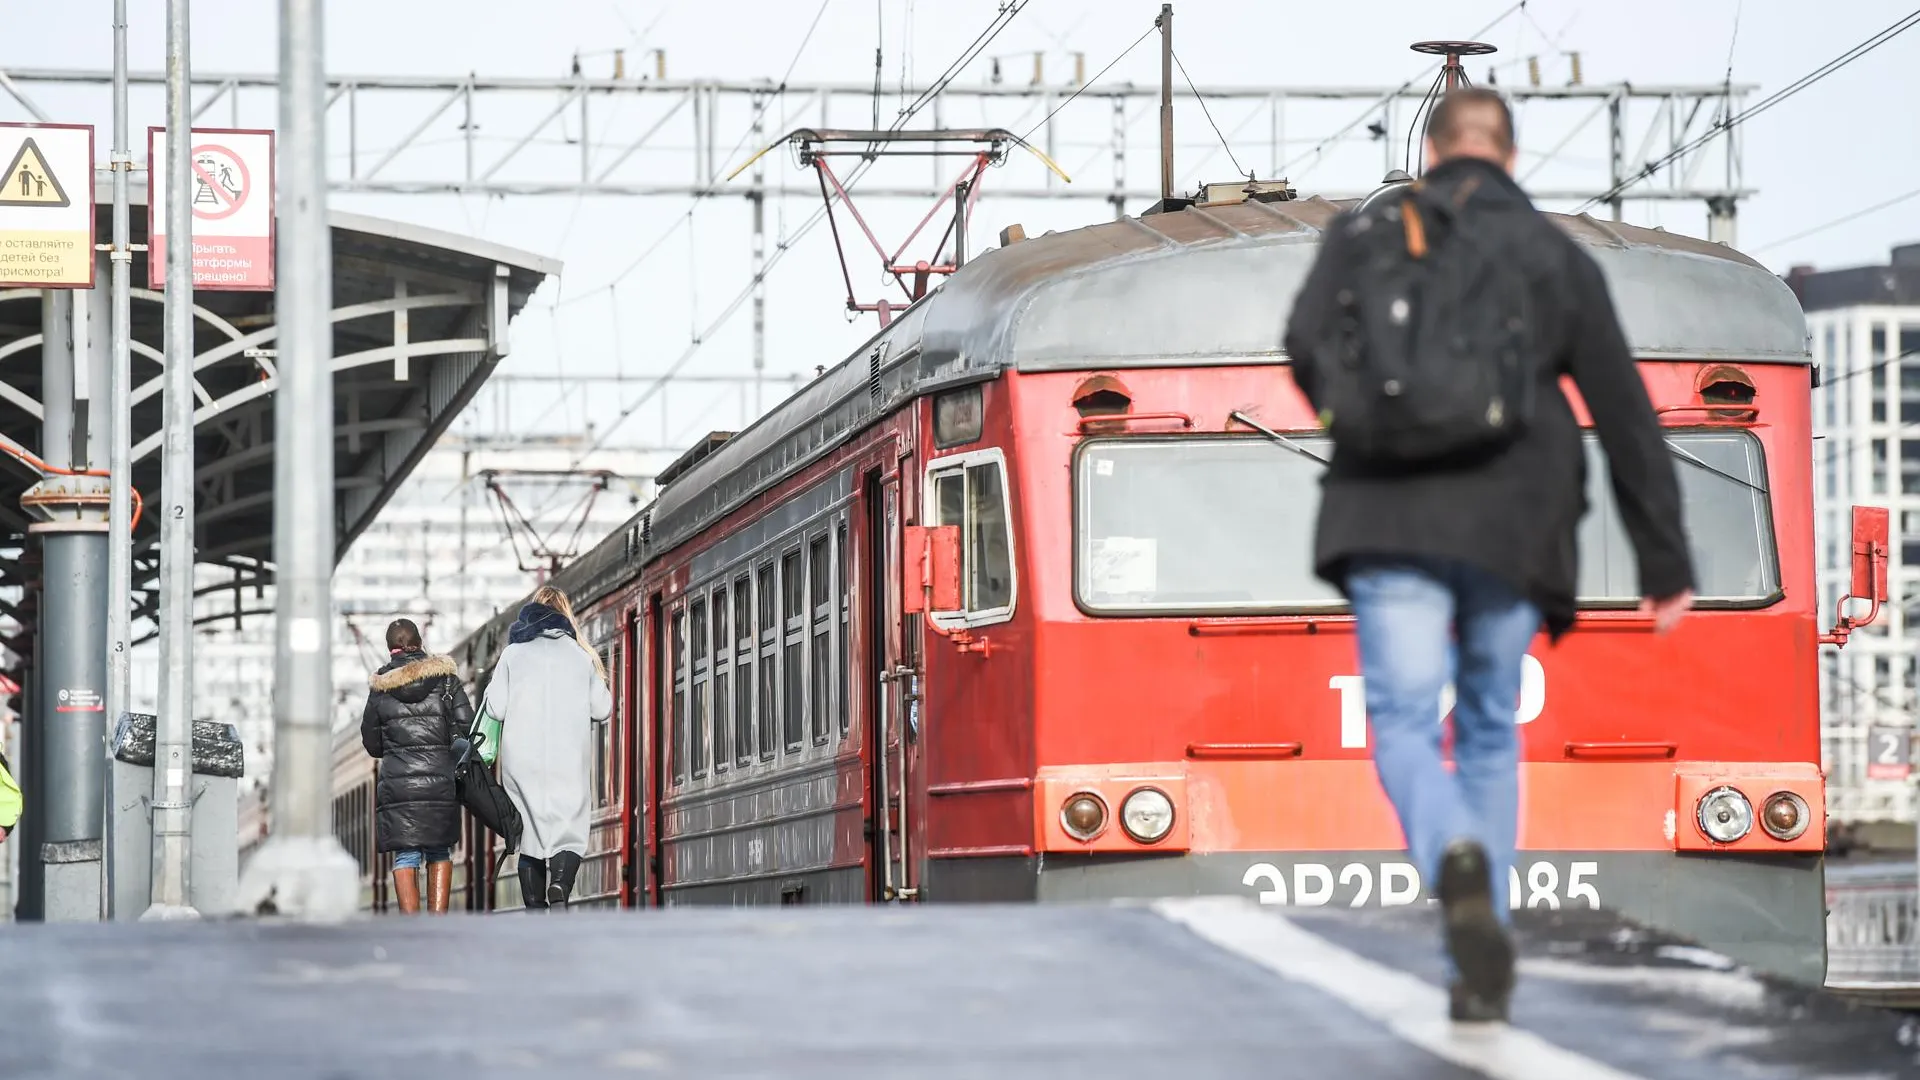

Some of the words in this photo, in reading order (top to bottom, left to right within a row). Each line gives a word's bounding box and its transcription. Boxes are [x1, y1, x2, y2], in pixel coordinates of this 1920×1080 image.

[5, 239, 75, 250] оставляйте
[0, 252, 36, 263] детей
[39, 252, 60, 263] без
[192, 258, 252, 270] атформы
[192, 271, 247, 283] прещено!
[173, 505, 184, 520] 2
[114, 641, 124, 653] 3
[1329, 653, 1546, 748] 10
[1878, 734, 1899, 764] 2
[1242, 861, 1600, 911] ЭР2Р-85
